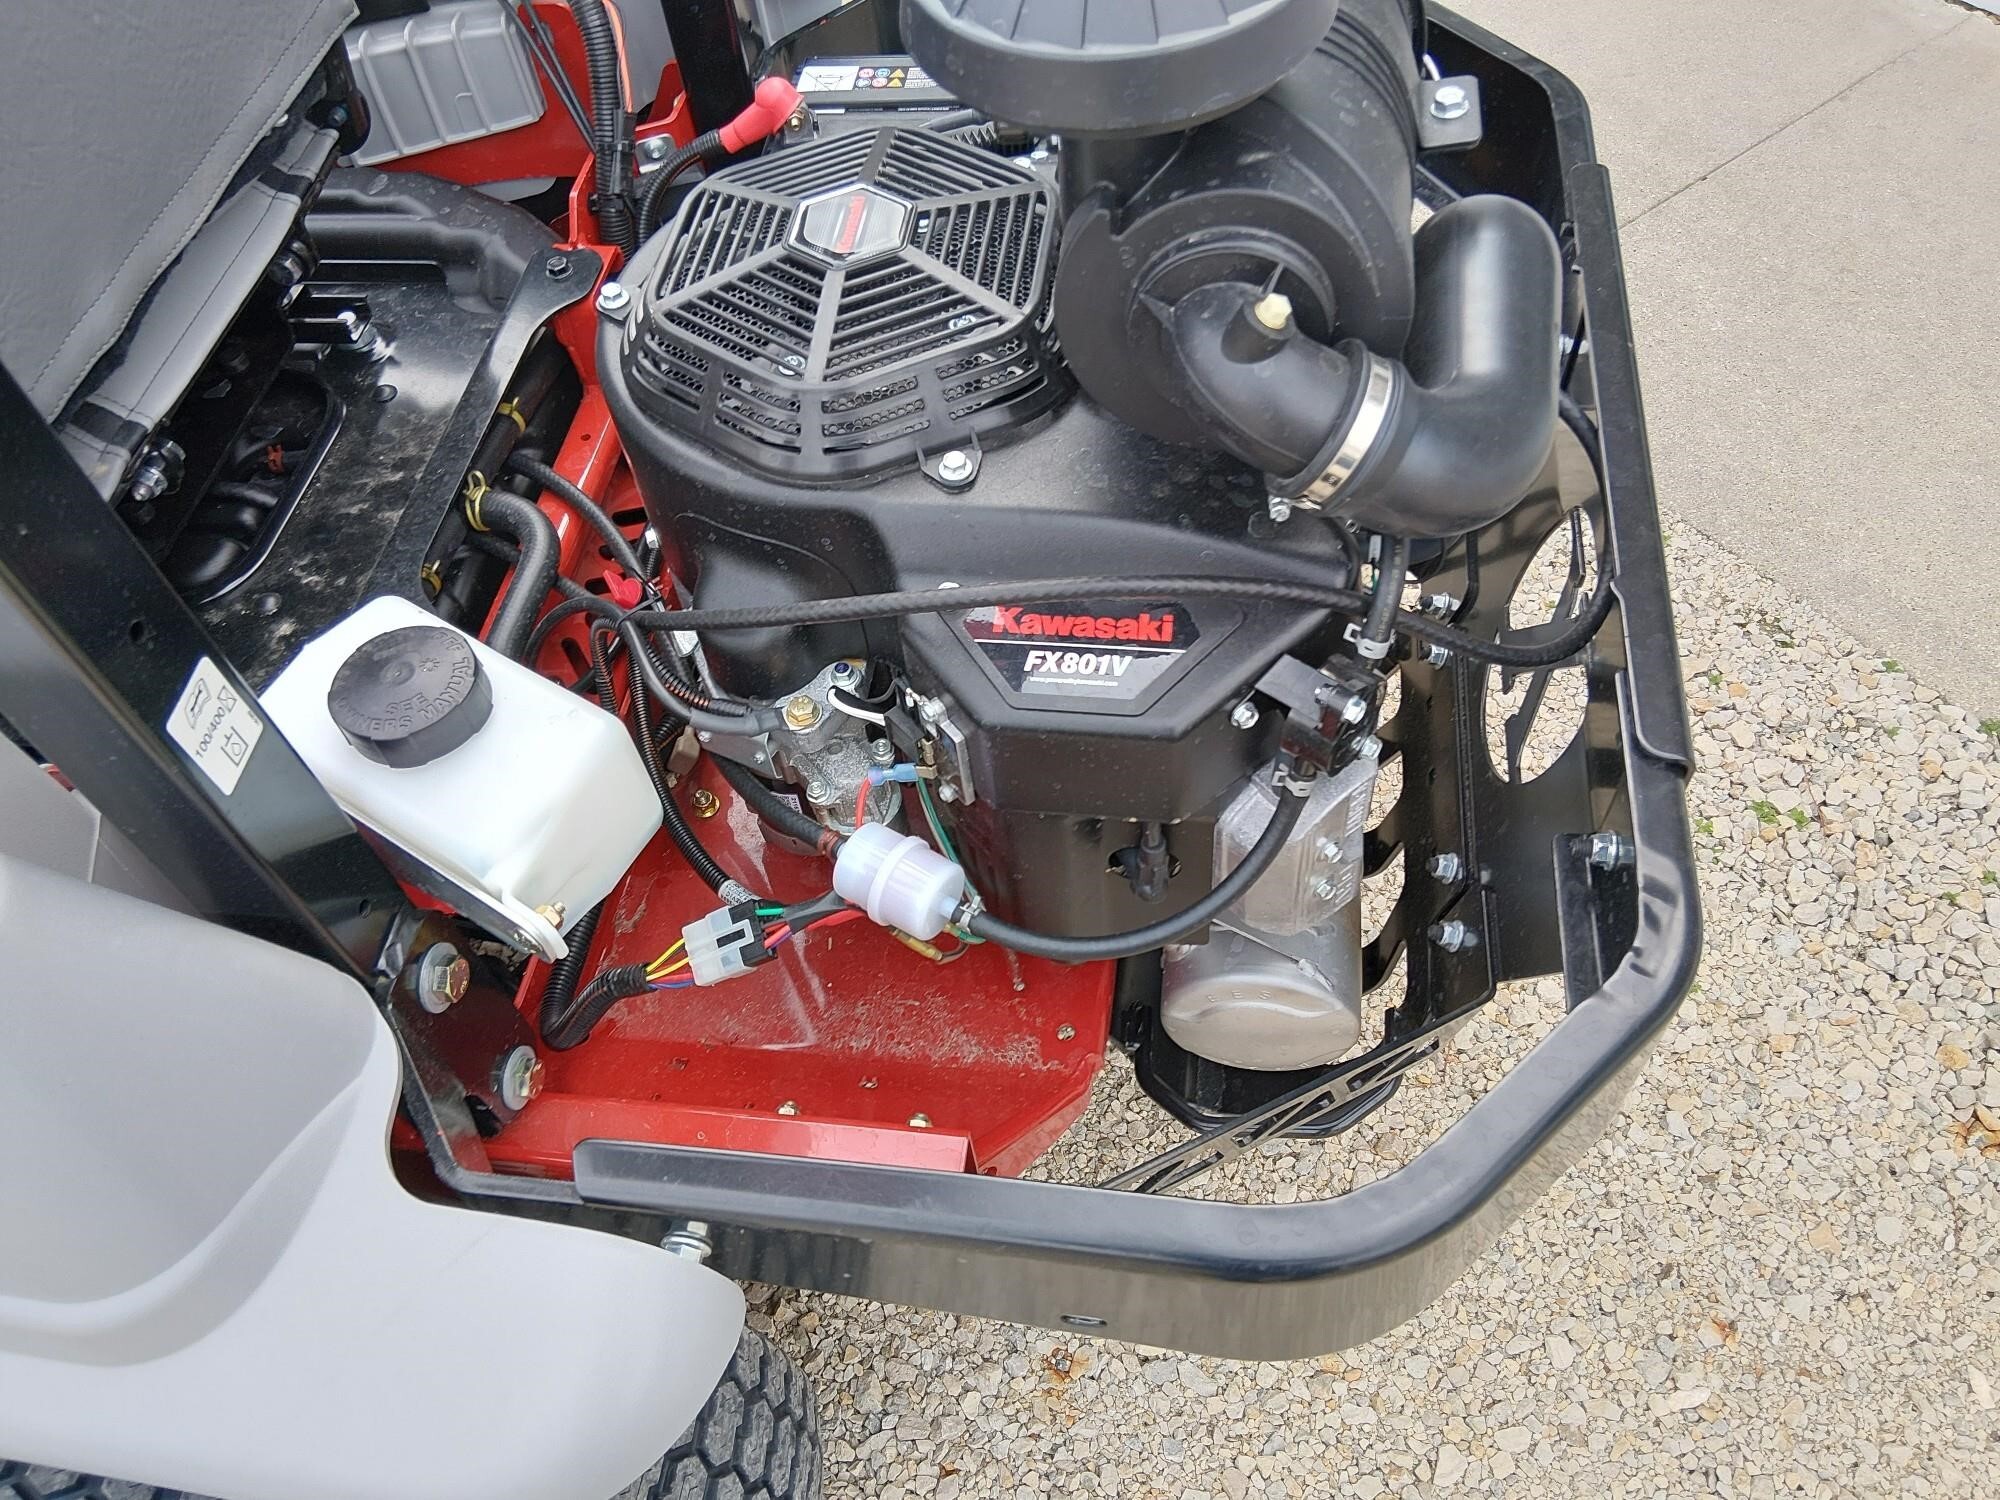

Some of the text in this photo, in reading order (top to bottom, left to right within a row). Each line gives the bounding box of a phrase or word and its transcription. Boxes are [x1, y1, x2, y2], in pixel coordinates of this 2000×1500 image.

[992, 605, 1175, 643] Kawasaki
[1023, 650, 1134, 677] FX801V
[385, 692, 429, 715] SEE
[417, 656, 473, 721] MANUAL
[195, 706, 227, 759] 100/400
